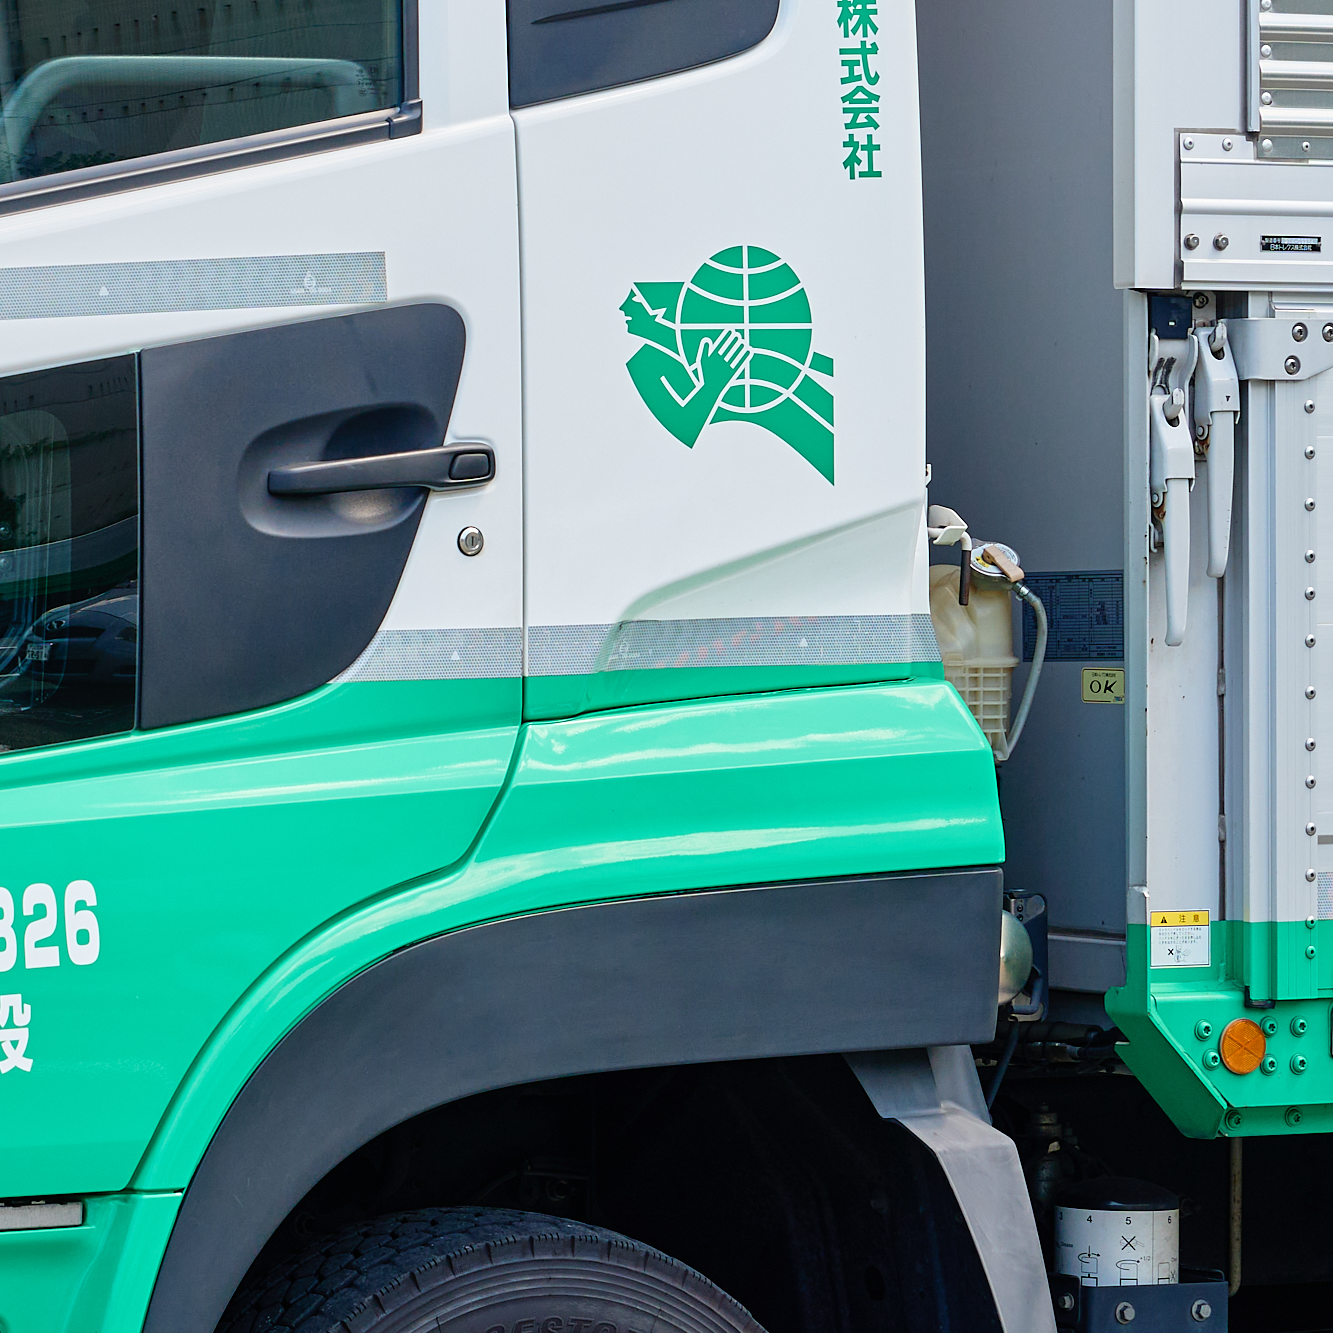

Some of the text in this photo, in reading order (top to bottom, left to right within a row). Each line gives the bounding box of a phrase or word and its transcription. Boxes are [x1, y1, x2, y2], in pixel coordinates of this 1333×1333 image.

[1089, 679, 1118, 694] OK
[1086, 1215, 1093, 1223] 4
[1125, 1216, 1132, 1225] 5
[1167, 1215, 1172, 1224] 6
